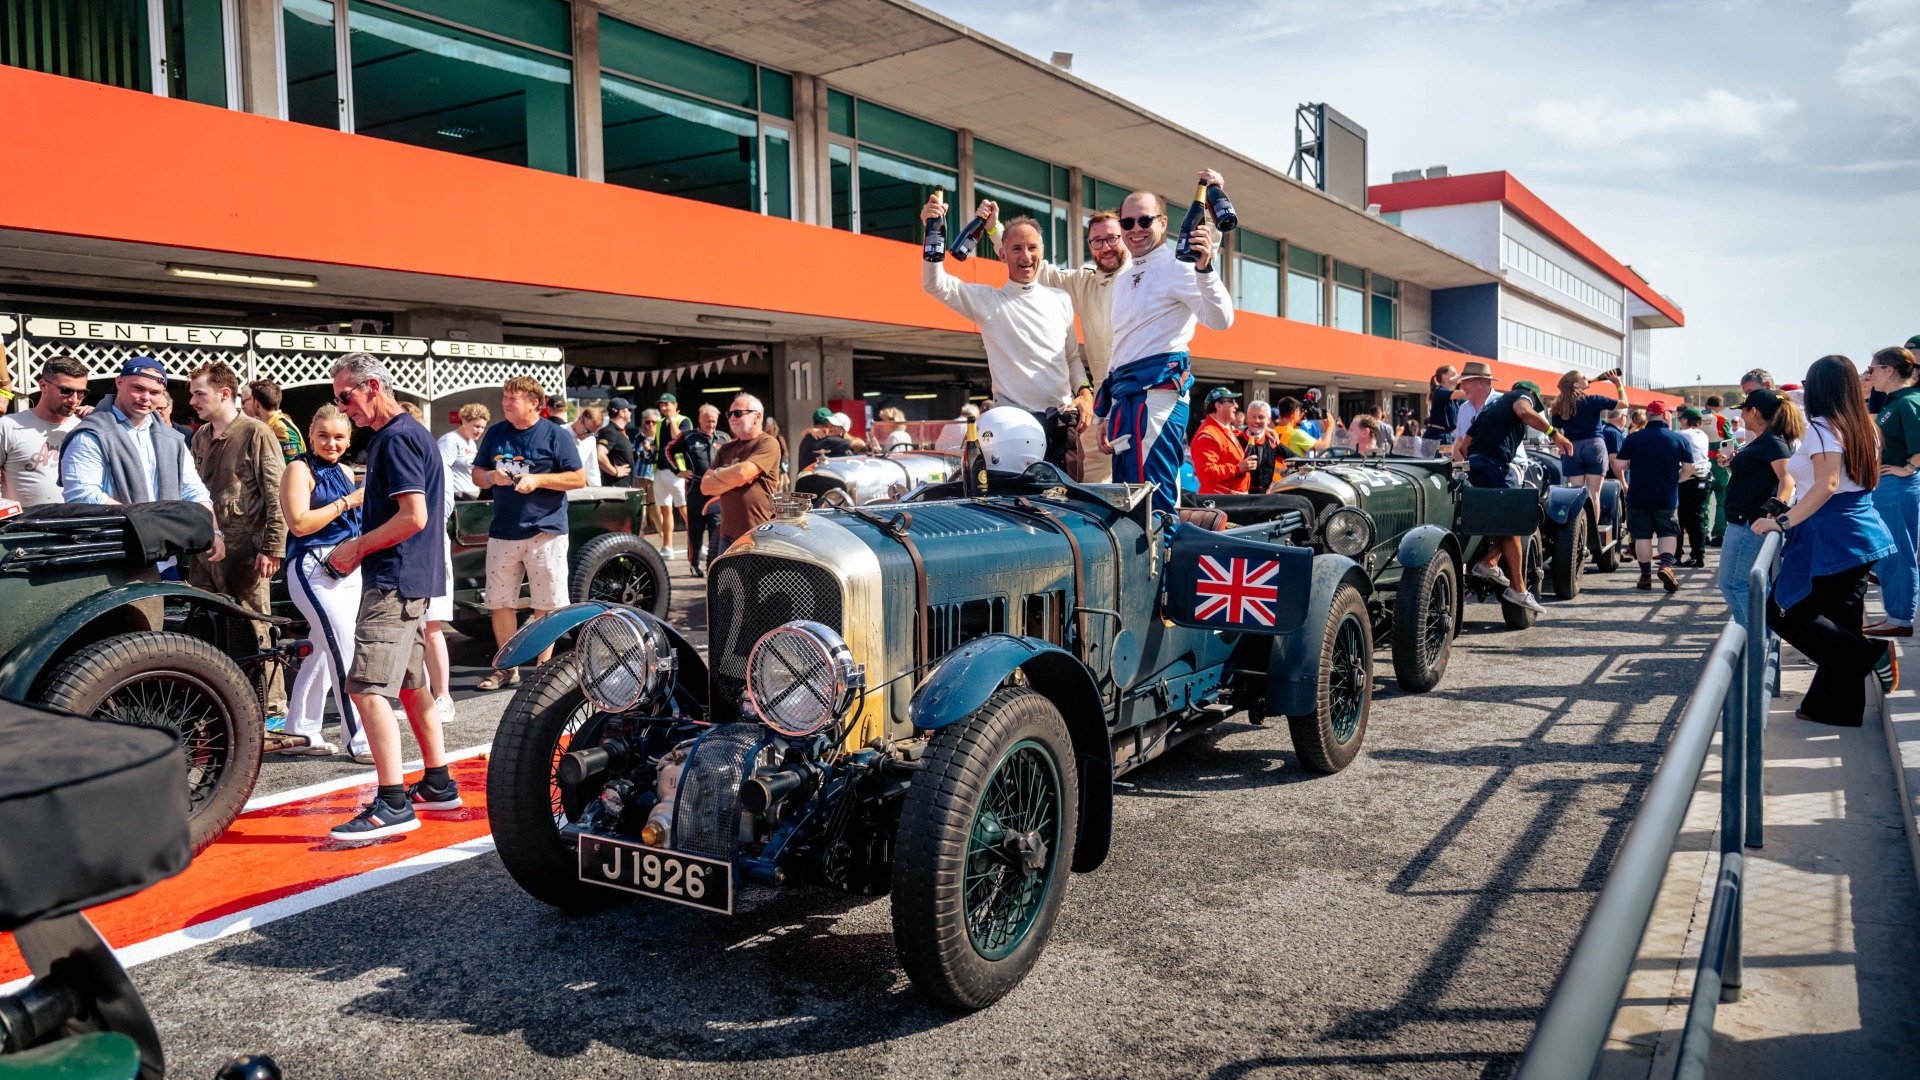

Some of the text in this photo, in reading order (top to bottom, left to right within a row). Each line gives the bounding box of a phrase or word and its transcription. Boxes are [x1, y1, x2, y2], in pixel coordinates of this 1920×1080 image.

[58, 321, 224, 344] BENTLEY
[280, 335, 409, 353] BENTLEY
[450, 343, 548, 359] BENTLEY
[790, 361, 812, 400] 11
[1326, 394, 1336, 414] 07
[602, 847, 705, 899] J 1926
